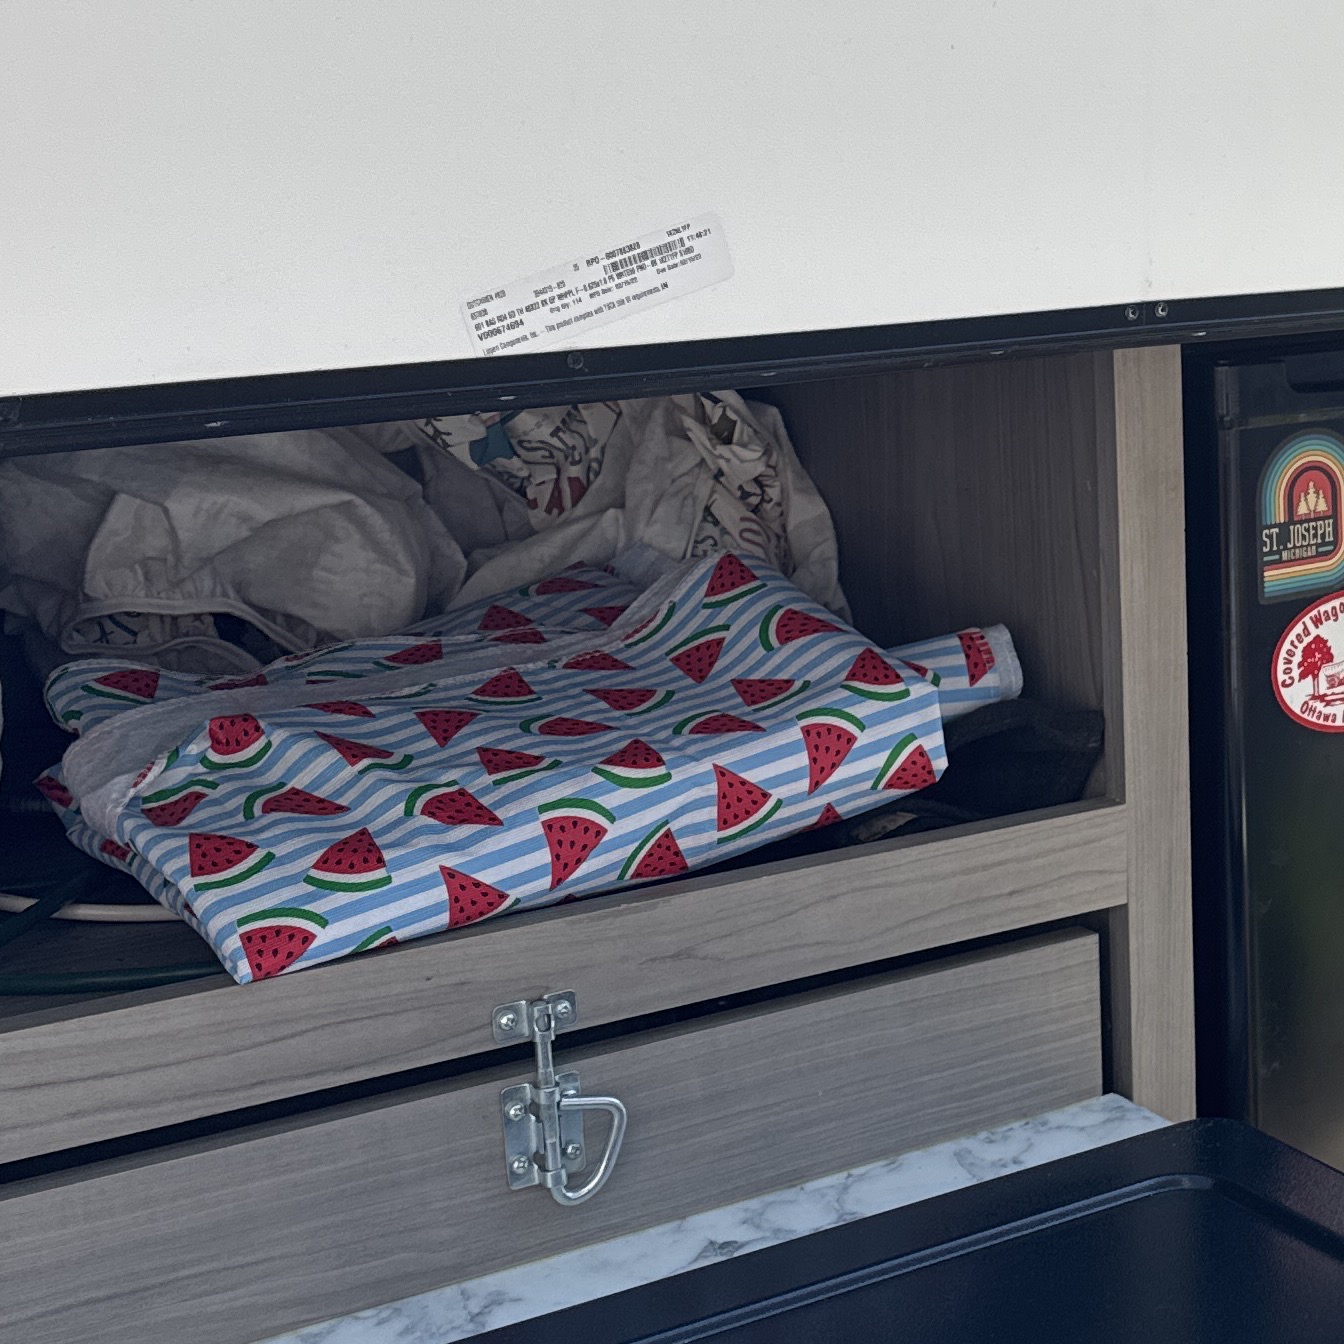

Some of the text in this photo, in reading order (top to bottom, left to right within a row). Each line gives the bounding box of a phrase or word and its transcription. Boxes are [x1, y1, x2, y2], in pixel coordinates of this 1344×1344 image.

[1262, 519, 1334, 553] ST. JOSEPH
[1281, 545, 1317, 561] MICHIGAN
[1281, 620, 1311, 688] Covered
[1300, 700, 1337, 724] Ottawa
